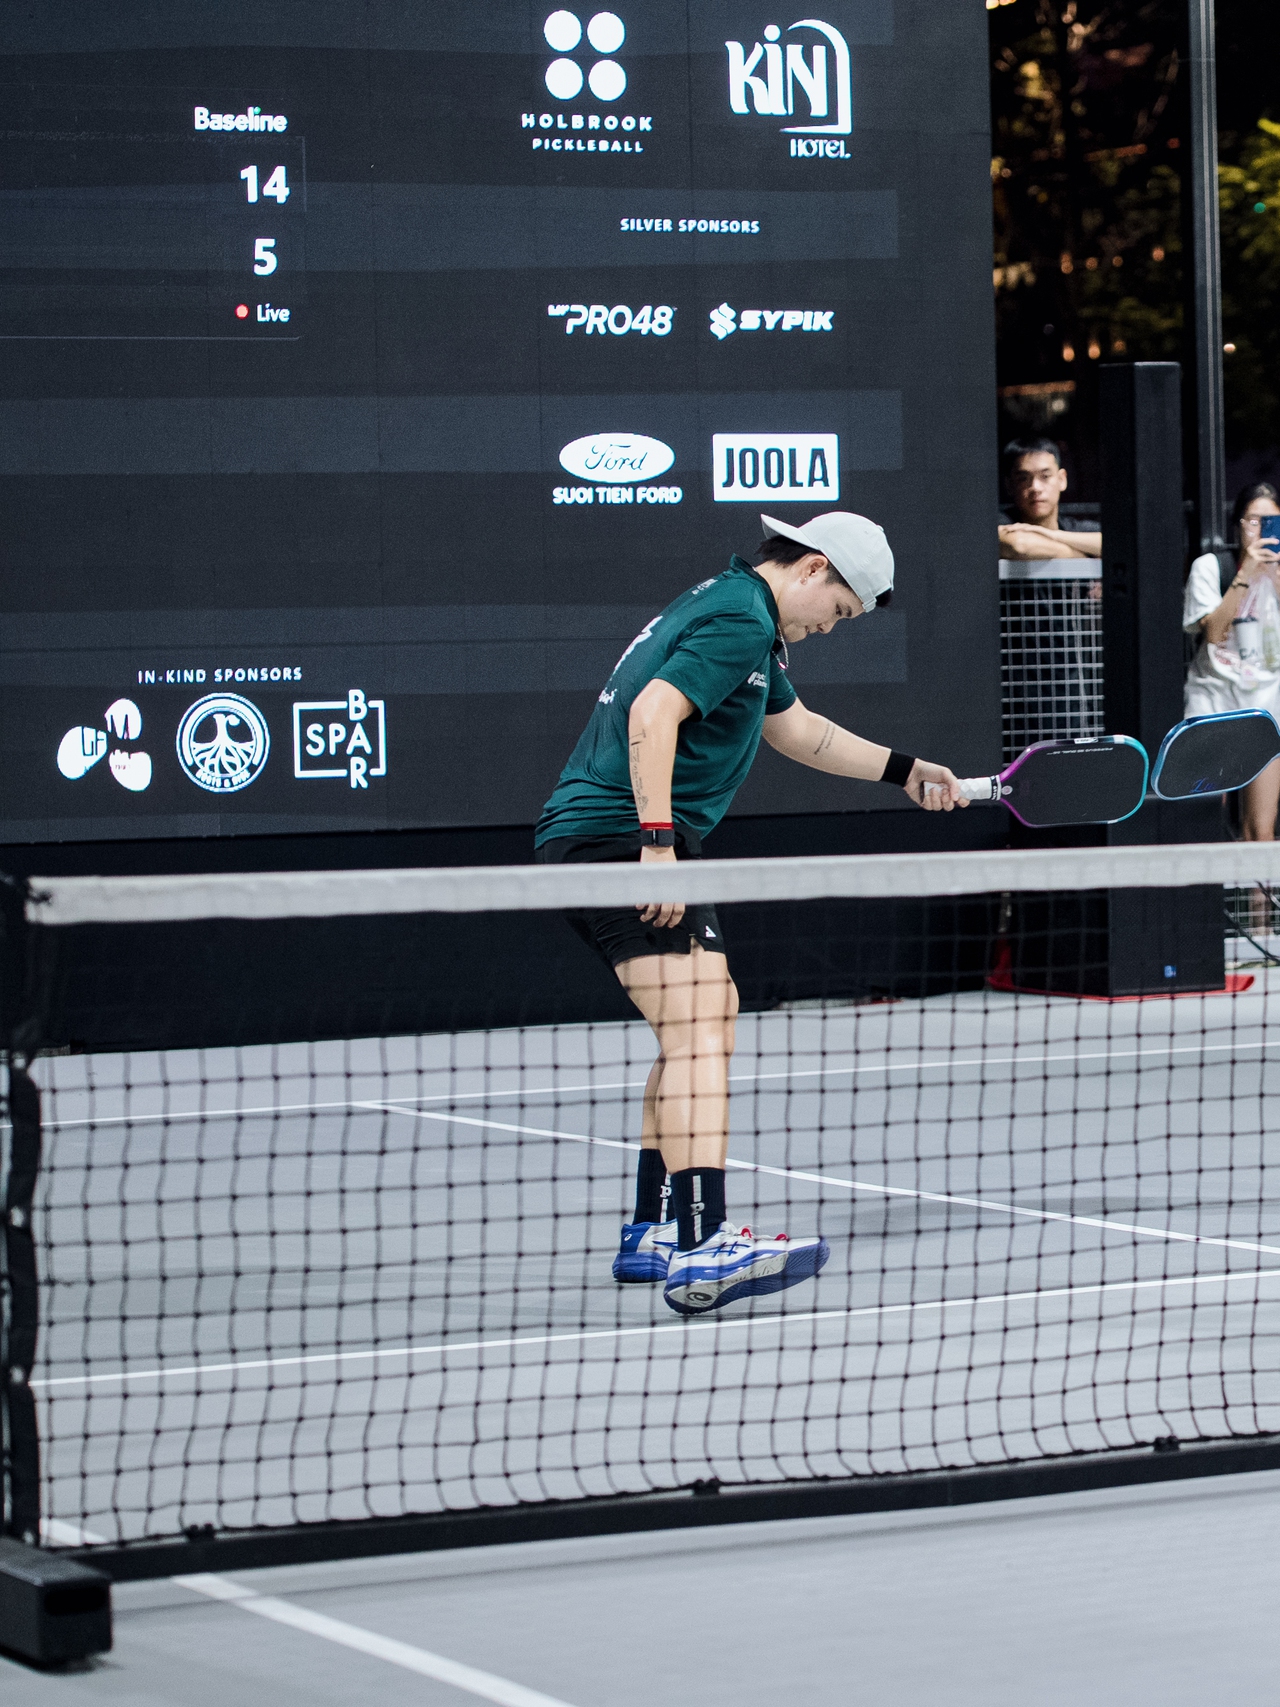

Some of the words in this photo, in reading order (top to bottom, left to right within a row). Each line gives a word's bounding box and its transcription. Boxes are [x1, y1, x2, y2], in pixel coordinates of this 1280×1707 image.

[194, 106, 288, 132] Baseline
[521, 113, 653, 131] HOLBROOK
[532, 138, 644, 153] PICKLEBALL
[790, 138, 852, 159] HOTEL
[240, 165, 290, 204] 14
[620, 218, 673, 233] SILVER
[678, 219, 760, 234] SPONSORS
[253, 238, 278, 276] 5
[256, 303, 291, 322] Live
[739, 310, 835, 331] SYPIK
[584, 443, 648, 471] Ford
[722, 447, 830, 489] JOOLA
[552, 487, 594, 505] SUOI
[594, 487, 634, 505] TIEN
[636, 487, 683, 505] FORD
[138, 669, 207, 684] IN-KIND
[214, 666, 303, 683] SPONSORS
[305, 722, 373, 757] SPA
